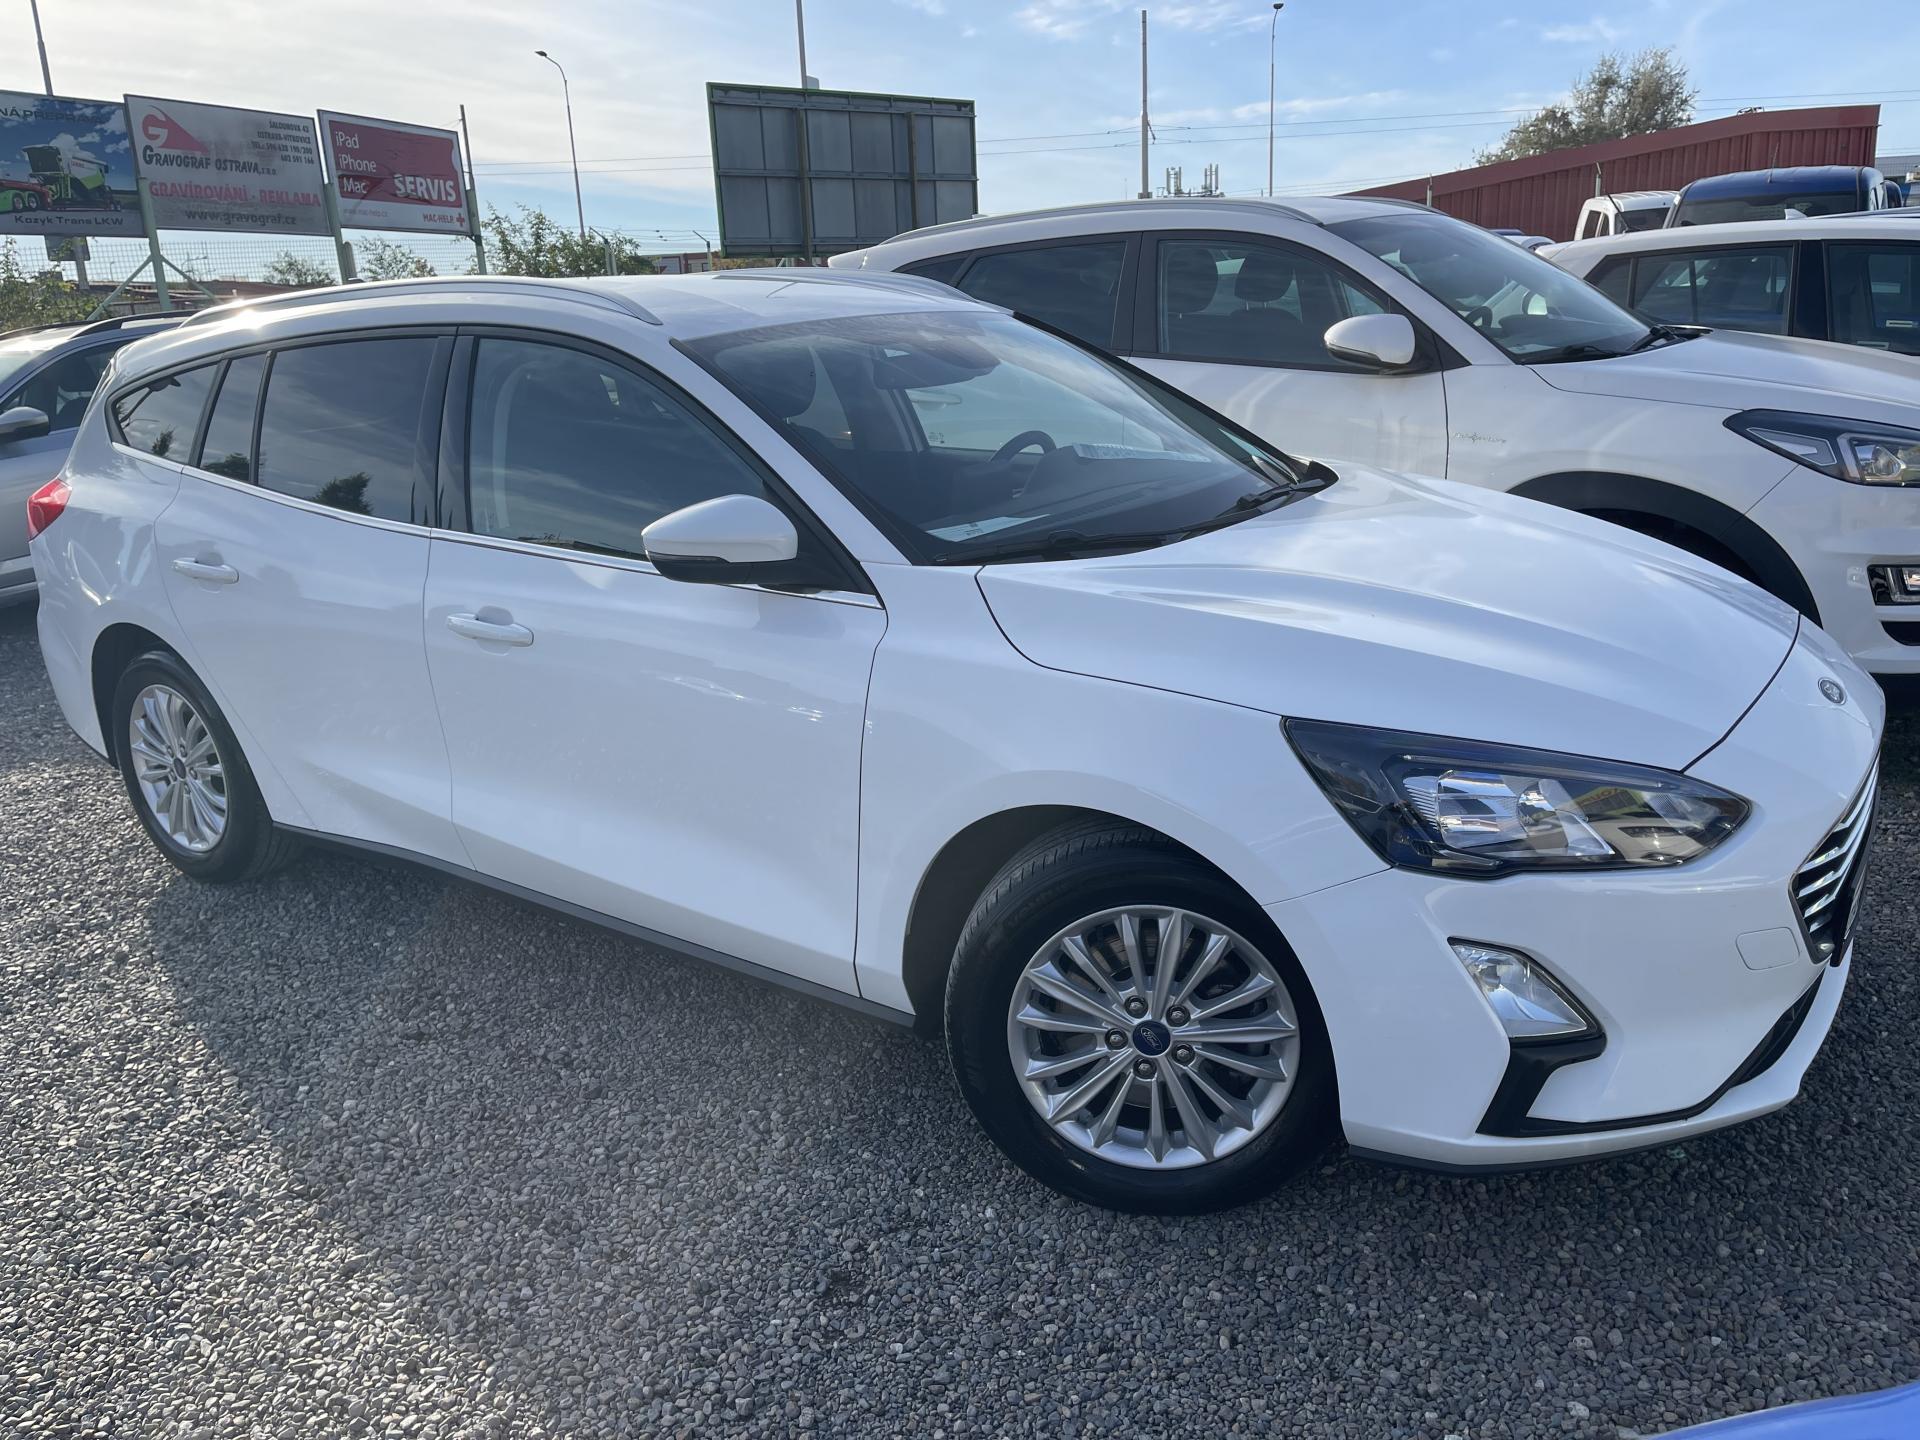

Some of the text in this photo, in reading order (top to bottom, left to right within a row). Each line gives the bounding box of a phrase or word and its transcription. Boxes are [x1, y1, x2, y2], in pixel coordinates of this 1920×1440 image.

[335, 131, 360, 149] iPad
[338, 153, 377, 173] iPhone
[343, 176, 368, 194] Mac
[393, 173, 457, 202] SERVIS
[259, 188, 321, 207] REKLAMA
[55, 216, 93, 225] Trans
[94, 217, 124, 226] LKW
[185, 208, 297, 226] www.gravograf.cz
